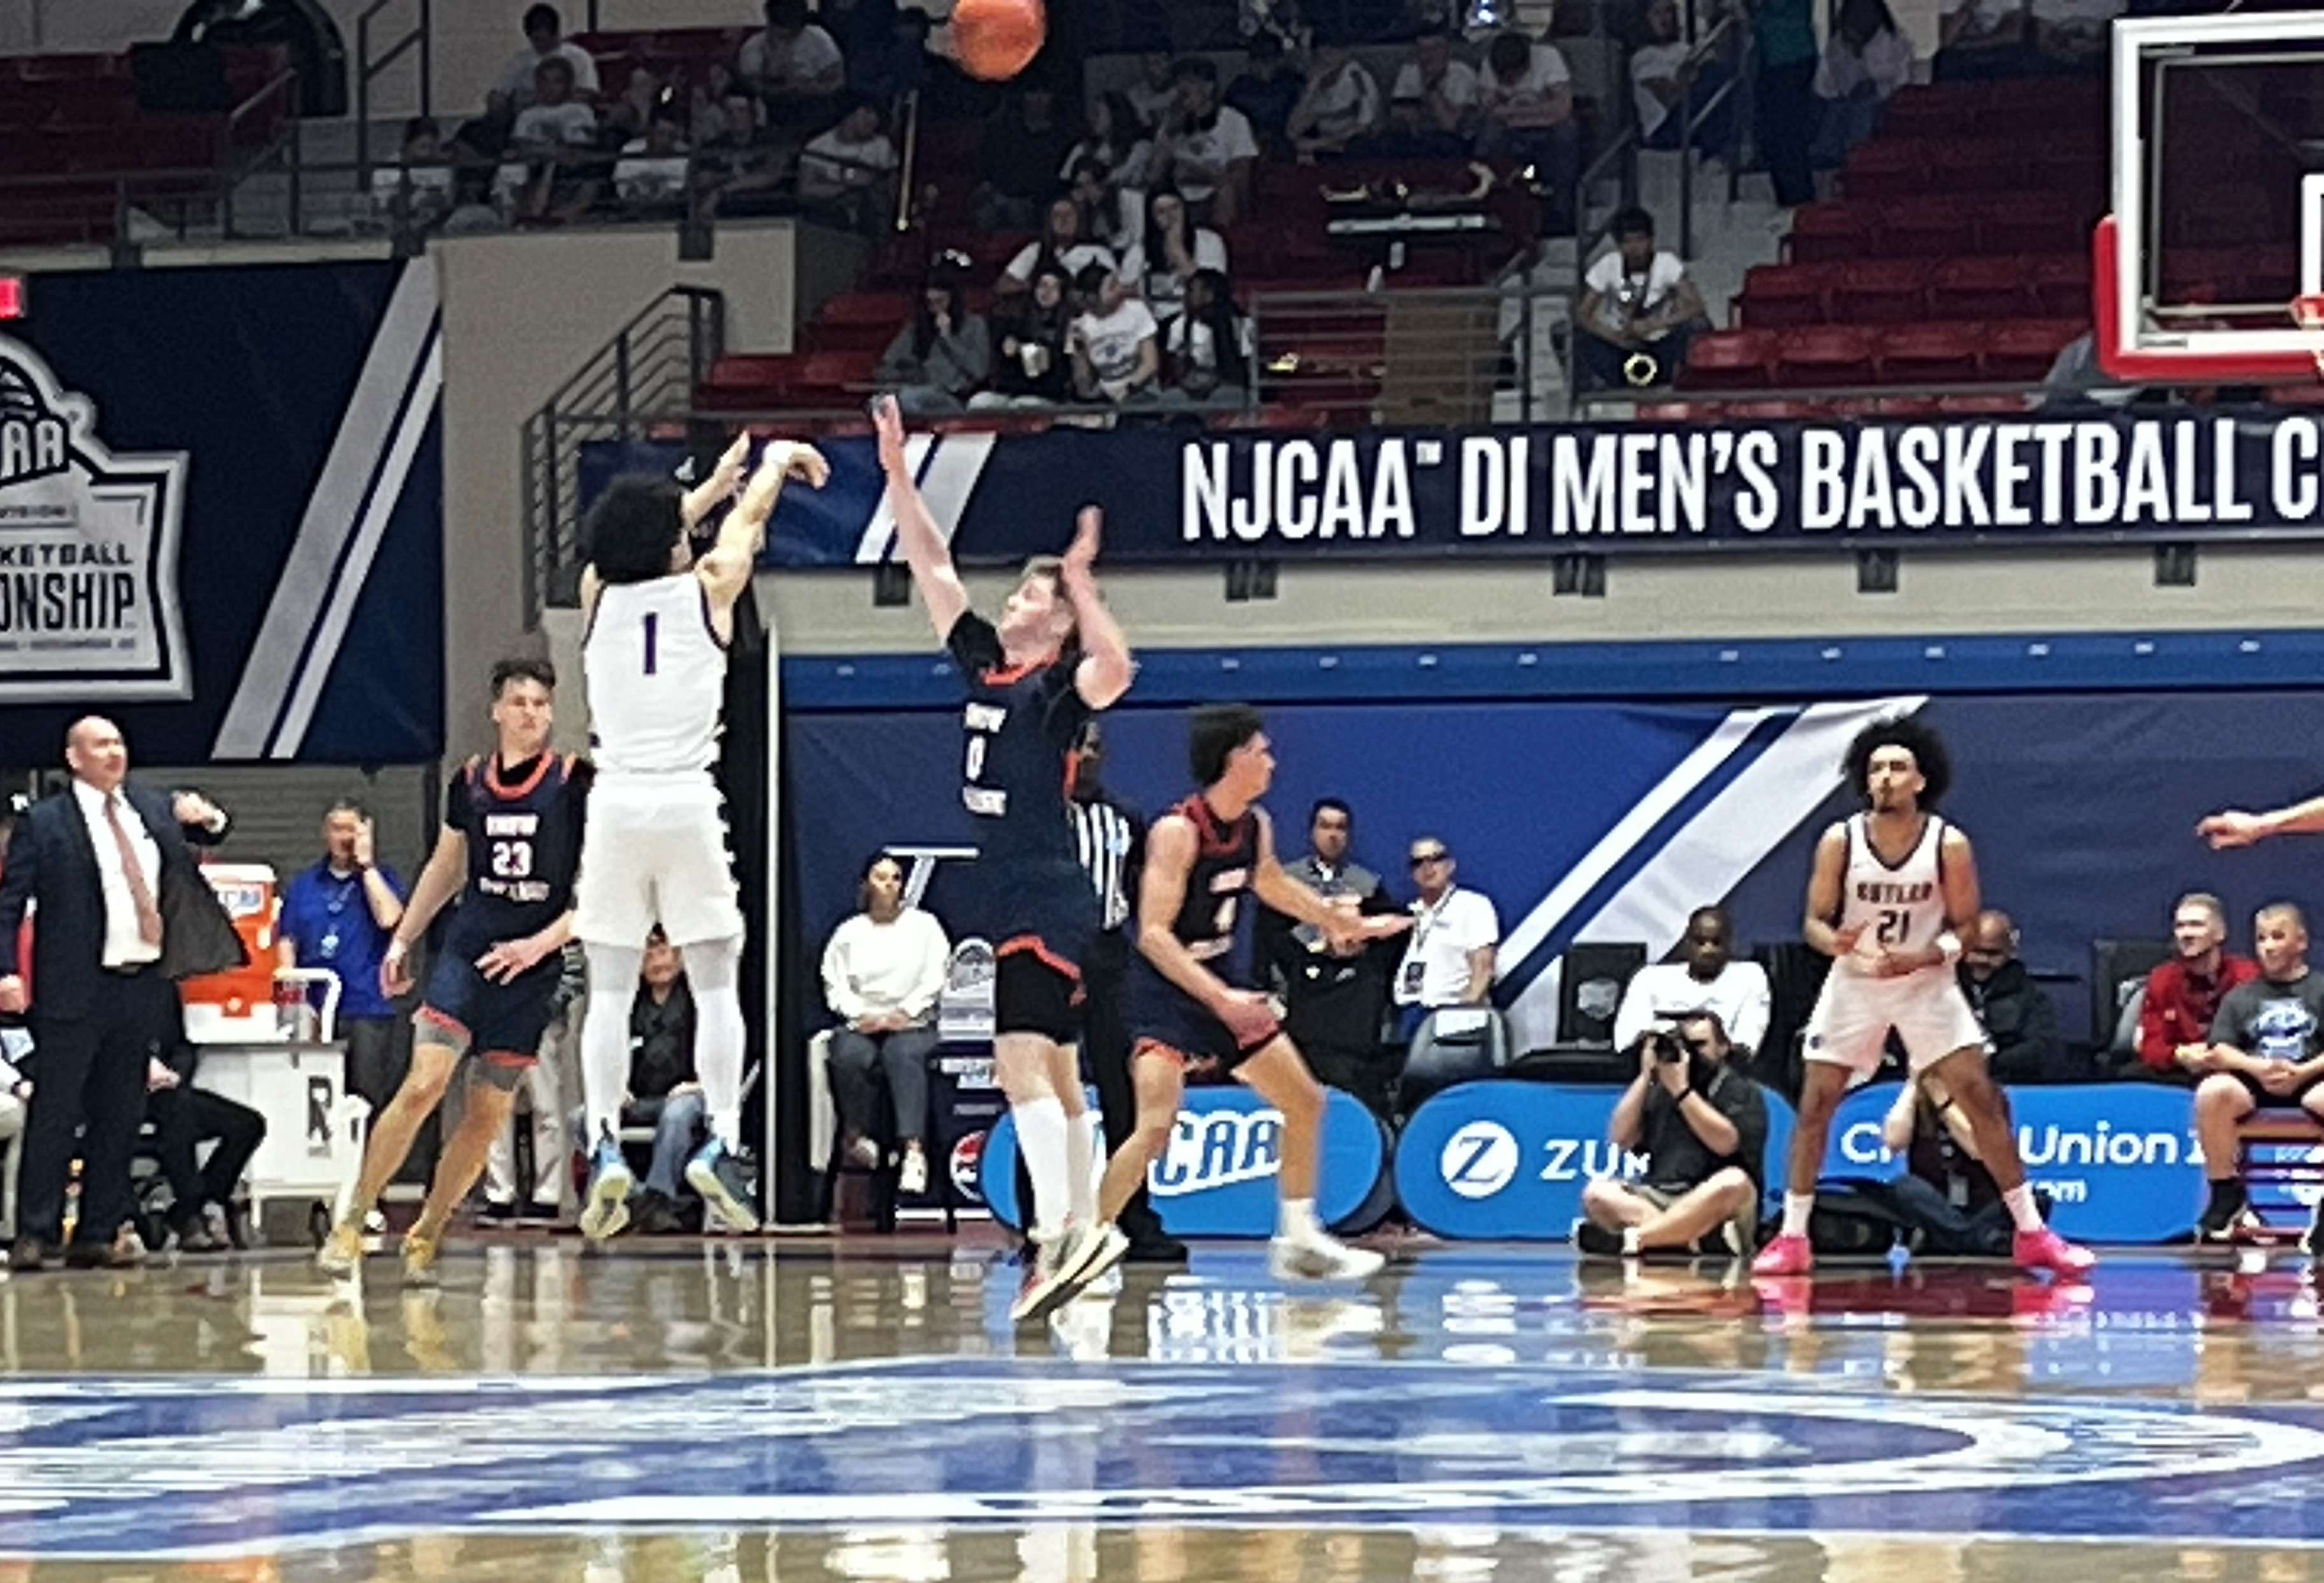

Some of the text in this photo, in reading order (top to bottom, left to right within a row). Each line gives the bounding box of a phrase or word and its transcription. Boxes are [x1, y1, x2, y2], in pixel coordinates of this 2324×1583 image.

[1460, 436, 1529, 536] DI
[1551, 433, 1780, 534] MEN'S
[1801, 419, 2253, 529] BASKETBALL
[643, 612, 657, 674] 1
[493, 841, 533, 877] 23
[1877, 909, 1910, 944] 21
[2018, 1120, 2179, 1164] Union
